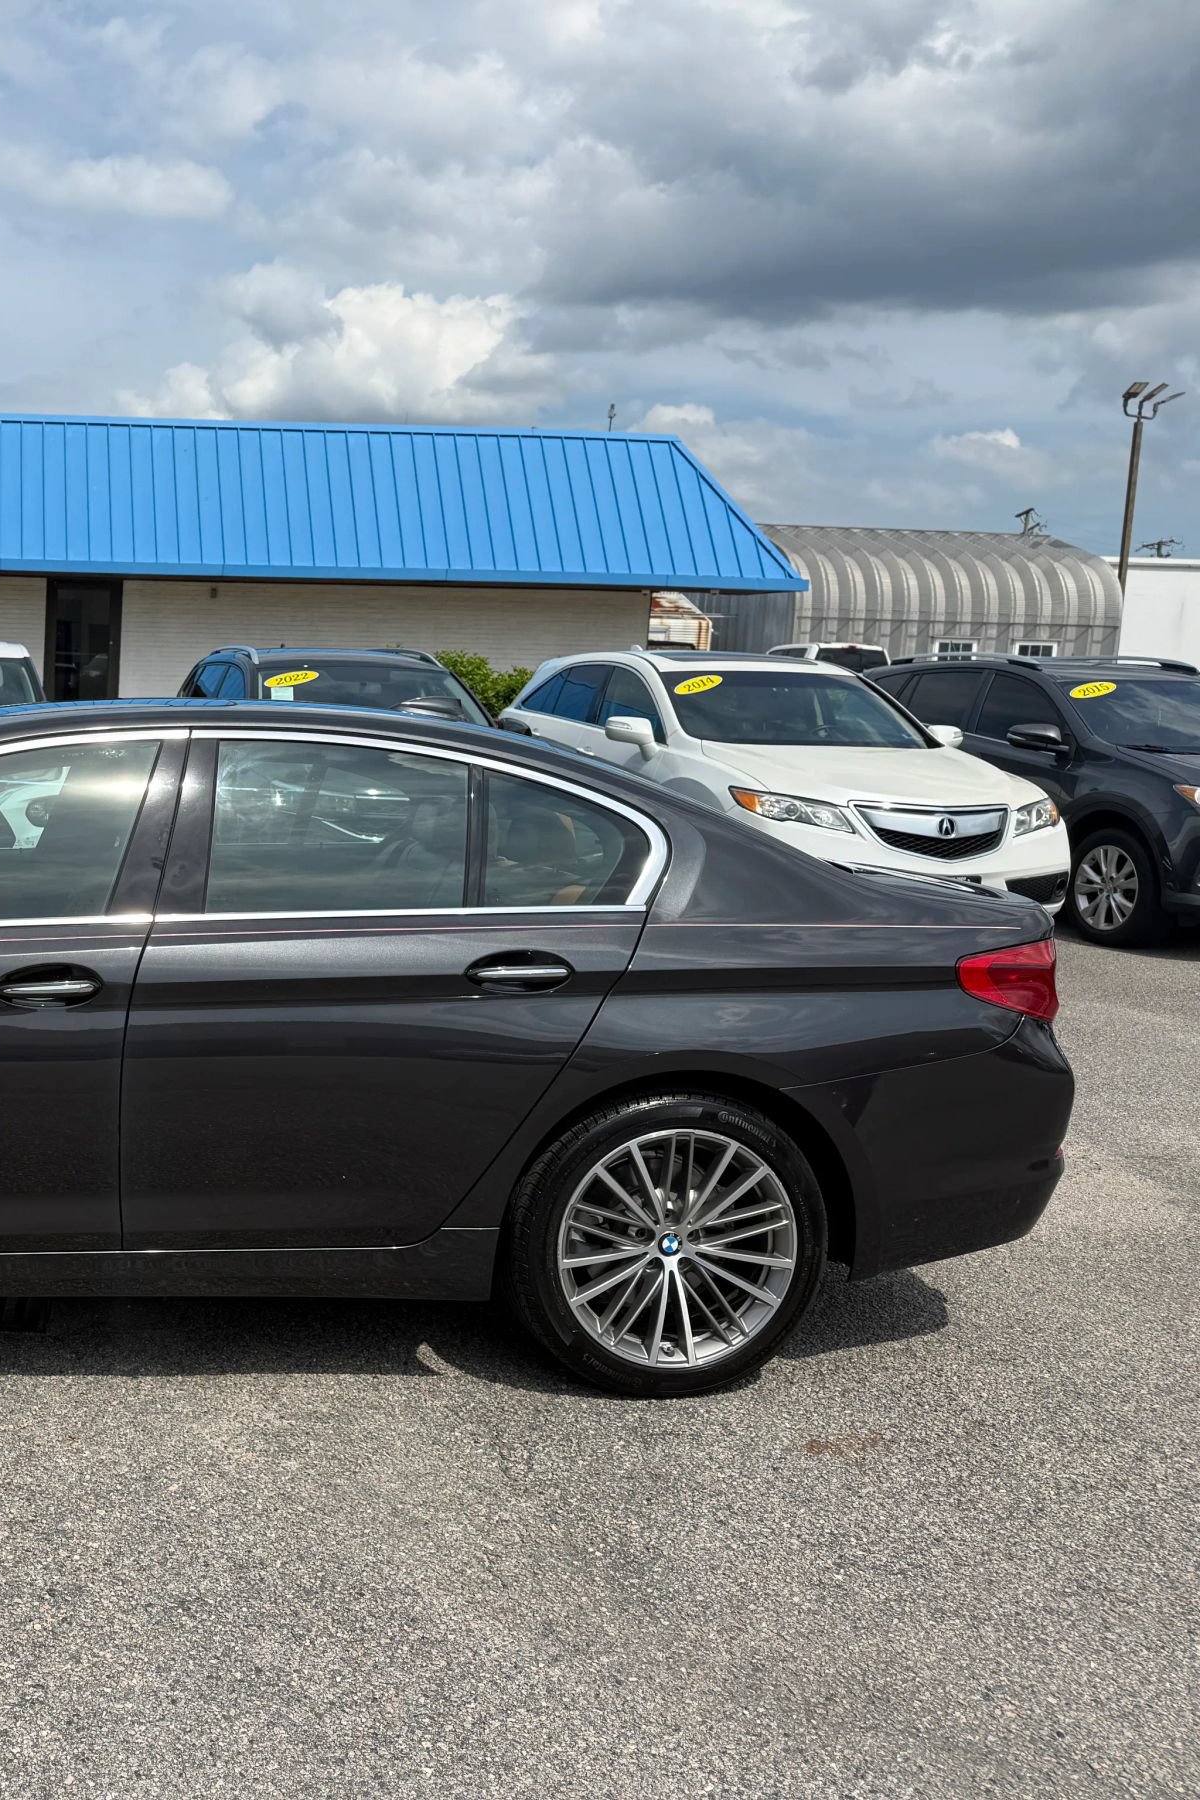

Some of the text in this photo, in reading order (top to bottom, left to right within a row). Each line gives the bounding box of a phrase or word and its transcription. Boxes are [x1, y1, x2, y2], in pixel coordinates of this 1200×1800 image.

[275, 672, 309, 686] 2022
[683, 676, 714, 692] 2014
[1078, 683, 1110, 696] 2015
